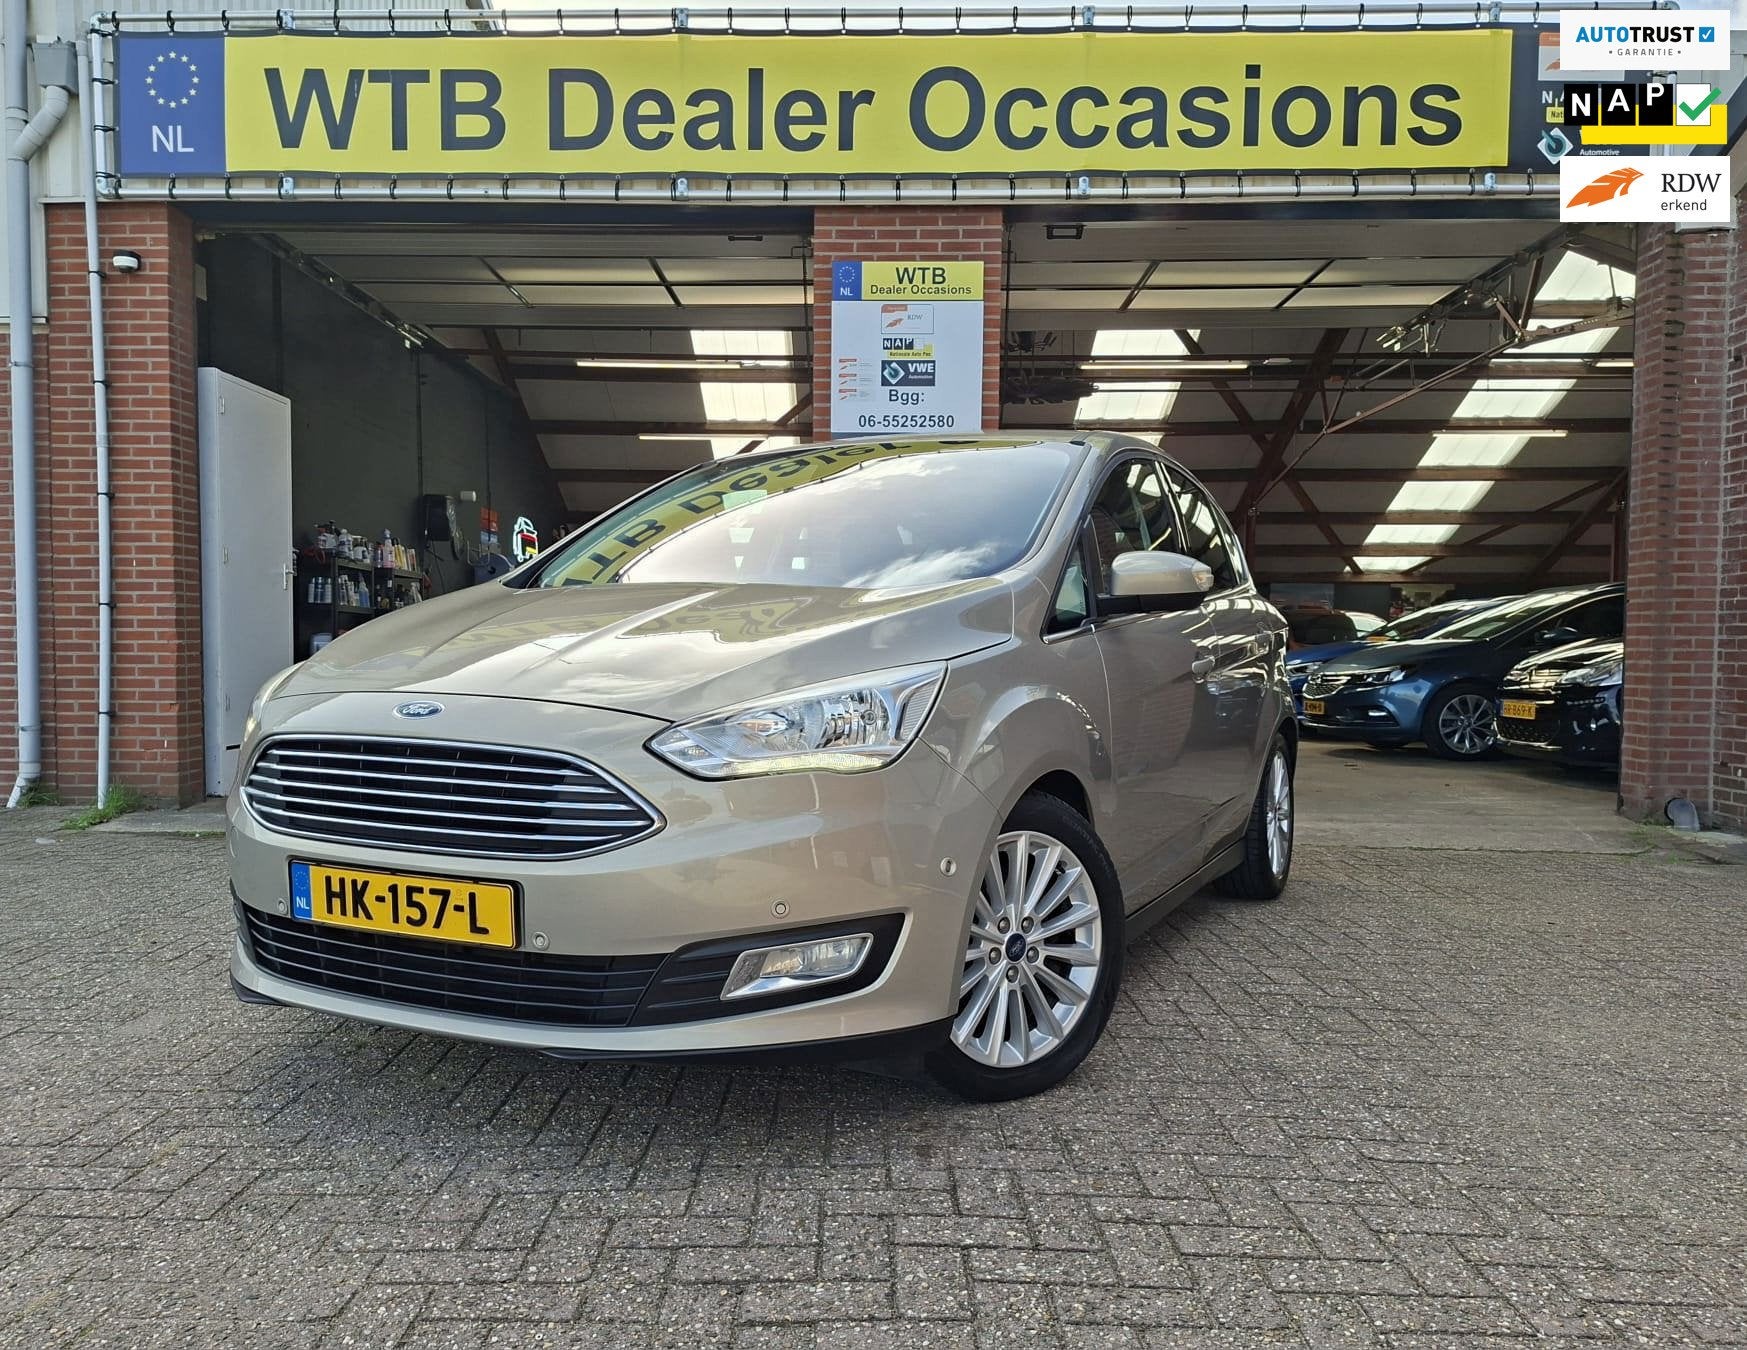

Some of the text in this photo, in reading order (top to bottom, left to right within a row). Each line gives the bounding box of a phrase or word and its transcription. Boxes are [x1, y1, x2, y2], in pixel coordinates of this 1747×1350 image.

[264, 64, 1463, 152] WTB Dealer Occasions
[151, 125, 194, 153] NL
[895, 267, 947, 285] WTB
[840, 287, 853, 296] NL
[870, 285, 972, 295] Dealer Occasions
[908, 362, 935, 373] VWE
[889, 389, 925, 405] Bgg:
[858, 415, 955, 428] 06-55252580
[296, 897, 310, 910] NL
[324, 875, 490, 934] HK-157-L
